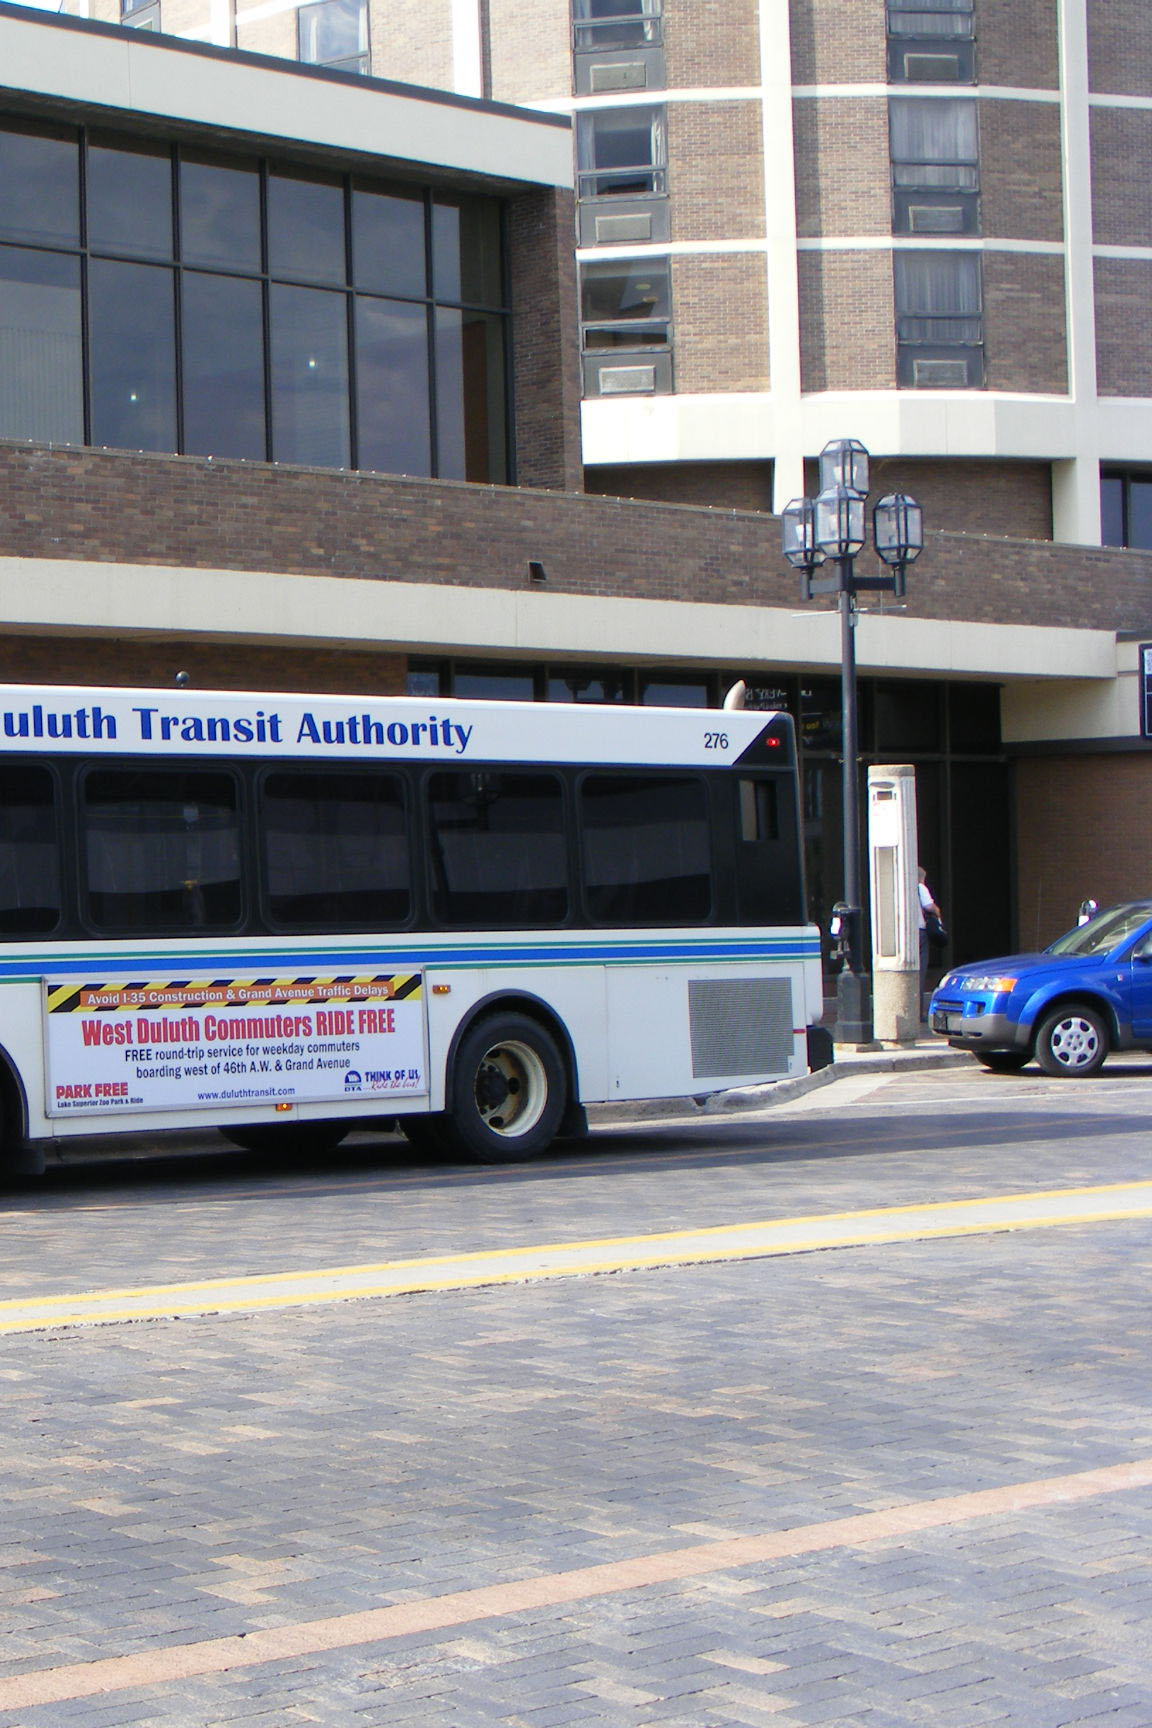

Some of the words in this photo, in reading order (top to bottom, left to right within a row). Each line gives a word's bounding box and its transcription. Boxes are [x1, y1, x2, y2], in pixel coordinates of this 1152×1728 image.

[132, 707, 283, 743] Transit
[297, 712, 473, 754] Authority
[704, 732, 729, 750] 276
[87, 993, 120, 1004] Avoid
[123, 992, 146, 1003] I-35
[149, 990, 223, 1002] Construction
[226, 989, 236, 1000] &
[238, 988, 272, 1000] Grand
[275, 987, 314, 998] Avenue
[317, 985, 351, 997] Traffic
[354, 984, 389, 998] Delays
[81, 1020, 134, 1046] West
[137, 1017, 200, 1043] Duluth
[204, 1014, 312, 1041] Commuters
[315, 1010, 355, 1036] RIDE
[358, 1008, 396, 1034] FREE
[125, 1049, 153, 1062] FREE
[155, 1047, 205, 1062] round-trip
[207, 1045, 244, 1058] service
[246, 1044, 261, 1056] for
[262, 1041, 305, 1057] weekday
[307, 1041, 360, 1053] commuters
[137, 1065, 181, 1079] boarding
[184, 1065, 209, 1076] west
[211, 1064, 222, 1075] of
[223, 1061, 247, 1075] 46th
[274, 1061, 283, 1072] &
[285, 1059, 314, 1071] Grand
[316, 1057, 350, 1069] Avenue
[364, 1070, 392, 1082] THINK
[394, 1069, 406, 1080] OF
[56, 1084, 92, 1099] PARK
[95, 1082, 128, 1097] FREE
[198, 1088, 296, 1100] www.duluthtransit.com
